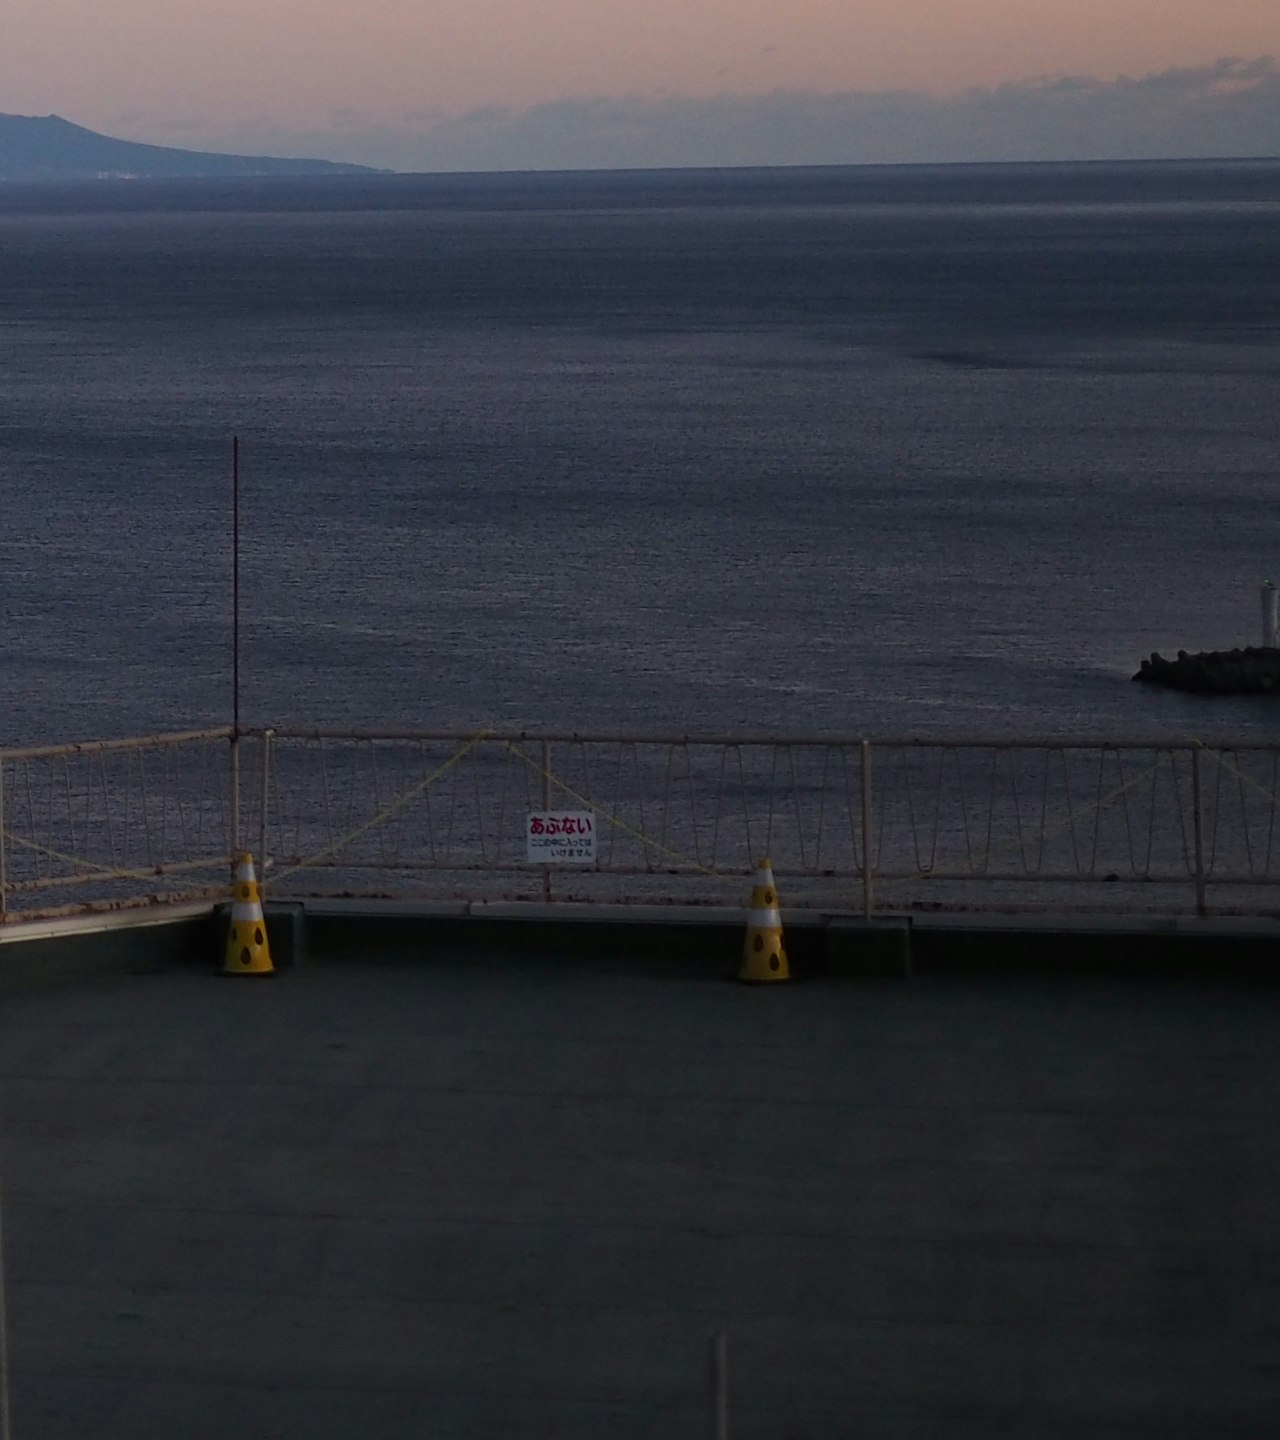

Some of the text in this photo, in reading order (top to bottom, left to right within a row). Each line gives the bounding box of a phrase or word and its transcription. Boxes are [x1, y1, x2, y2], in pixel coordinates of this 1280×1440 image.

[530, 816, 592, 835] あぶない
[531, 838, 592, 847] ここの中に入っては
[551, 849, 592, 857] いけません
